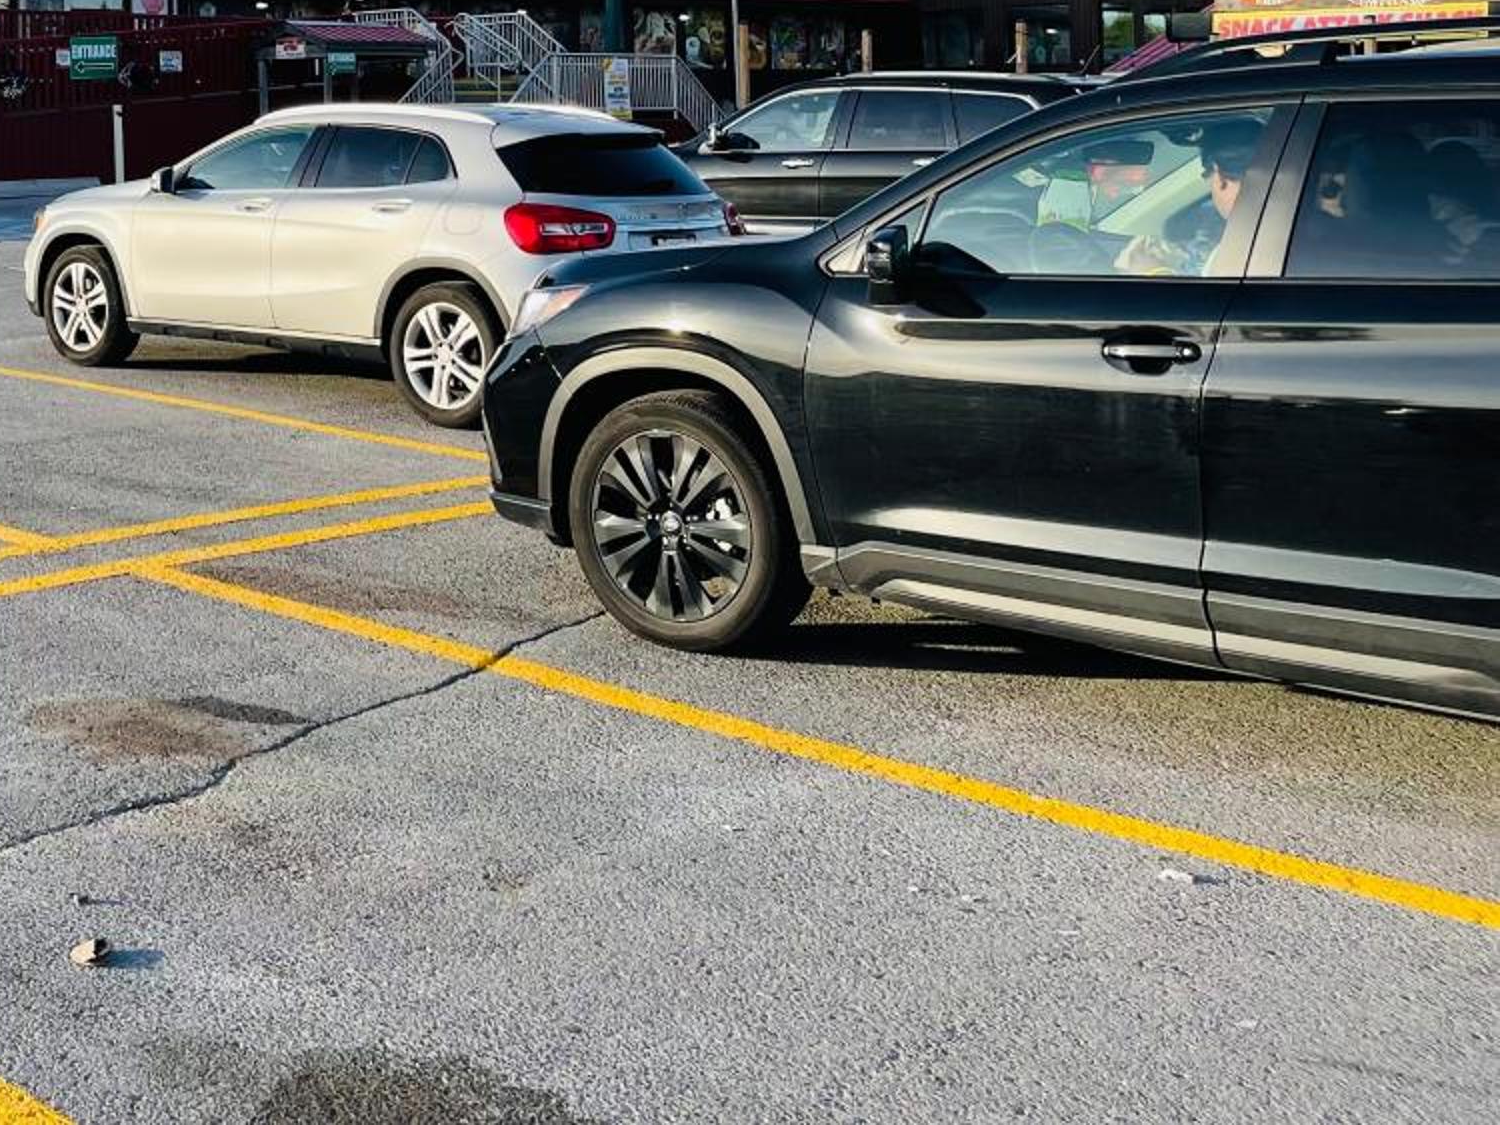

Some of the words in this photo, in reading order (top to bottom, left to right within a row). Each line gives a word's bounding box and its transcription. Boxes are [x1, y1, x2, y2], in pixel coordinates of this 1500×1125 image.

[1219, 17, 1293, 39] SNACK
[1304, 13, 1394, 30] ATTAK
[71, 44, 117, 60] ENTRANCE
